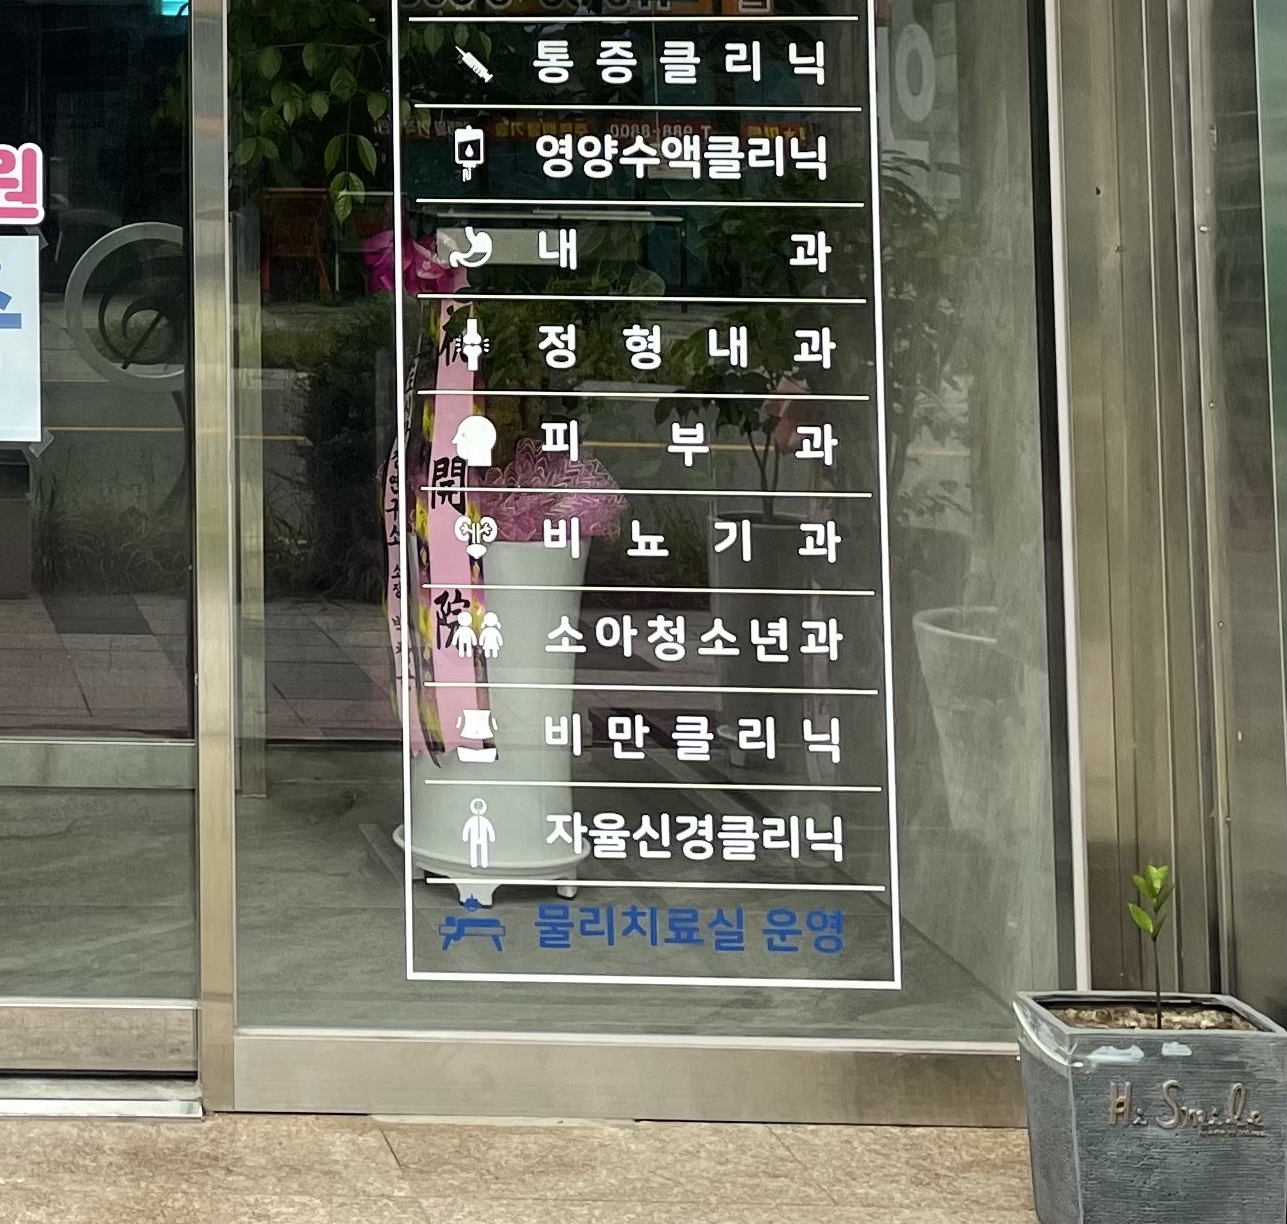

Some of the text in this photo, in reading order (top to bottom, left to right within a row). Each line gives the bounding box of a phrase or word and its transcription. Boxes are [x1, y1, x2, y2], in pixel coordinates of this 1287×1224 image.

[535, 134, 828, 181] 영양수액클리닉
[545, 614, 844, 663] 소아청소년과
[546, 811, 845, 863] 자율신경클리닉
[534, 904, 845, 955] 물리치료실 운영
